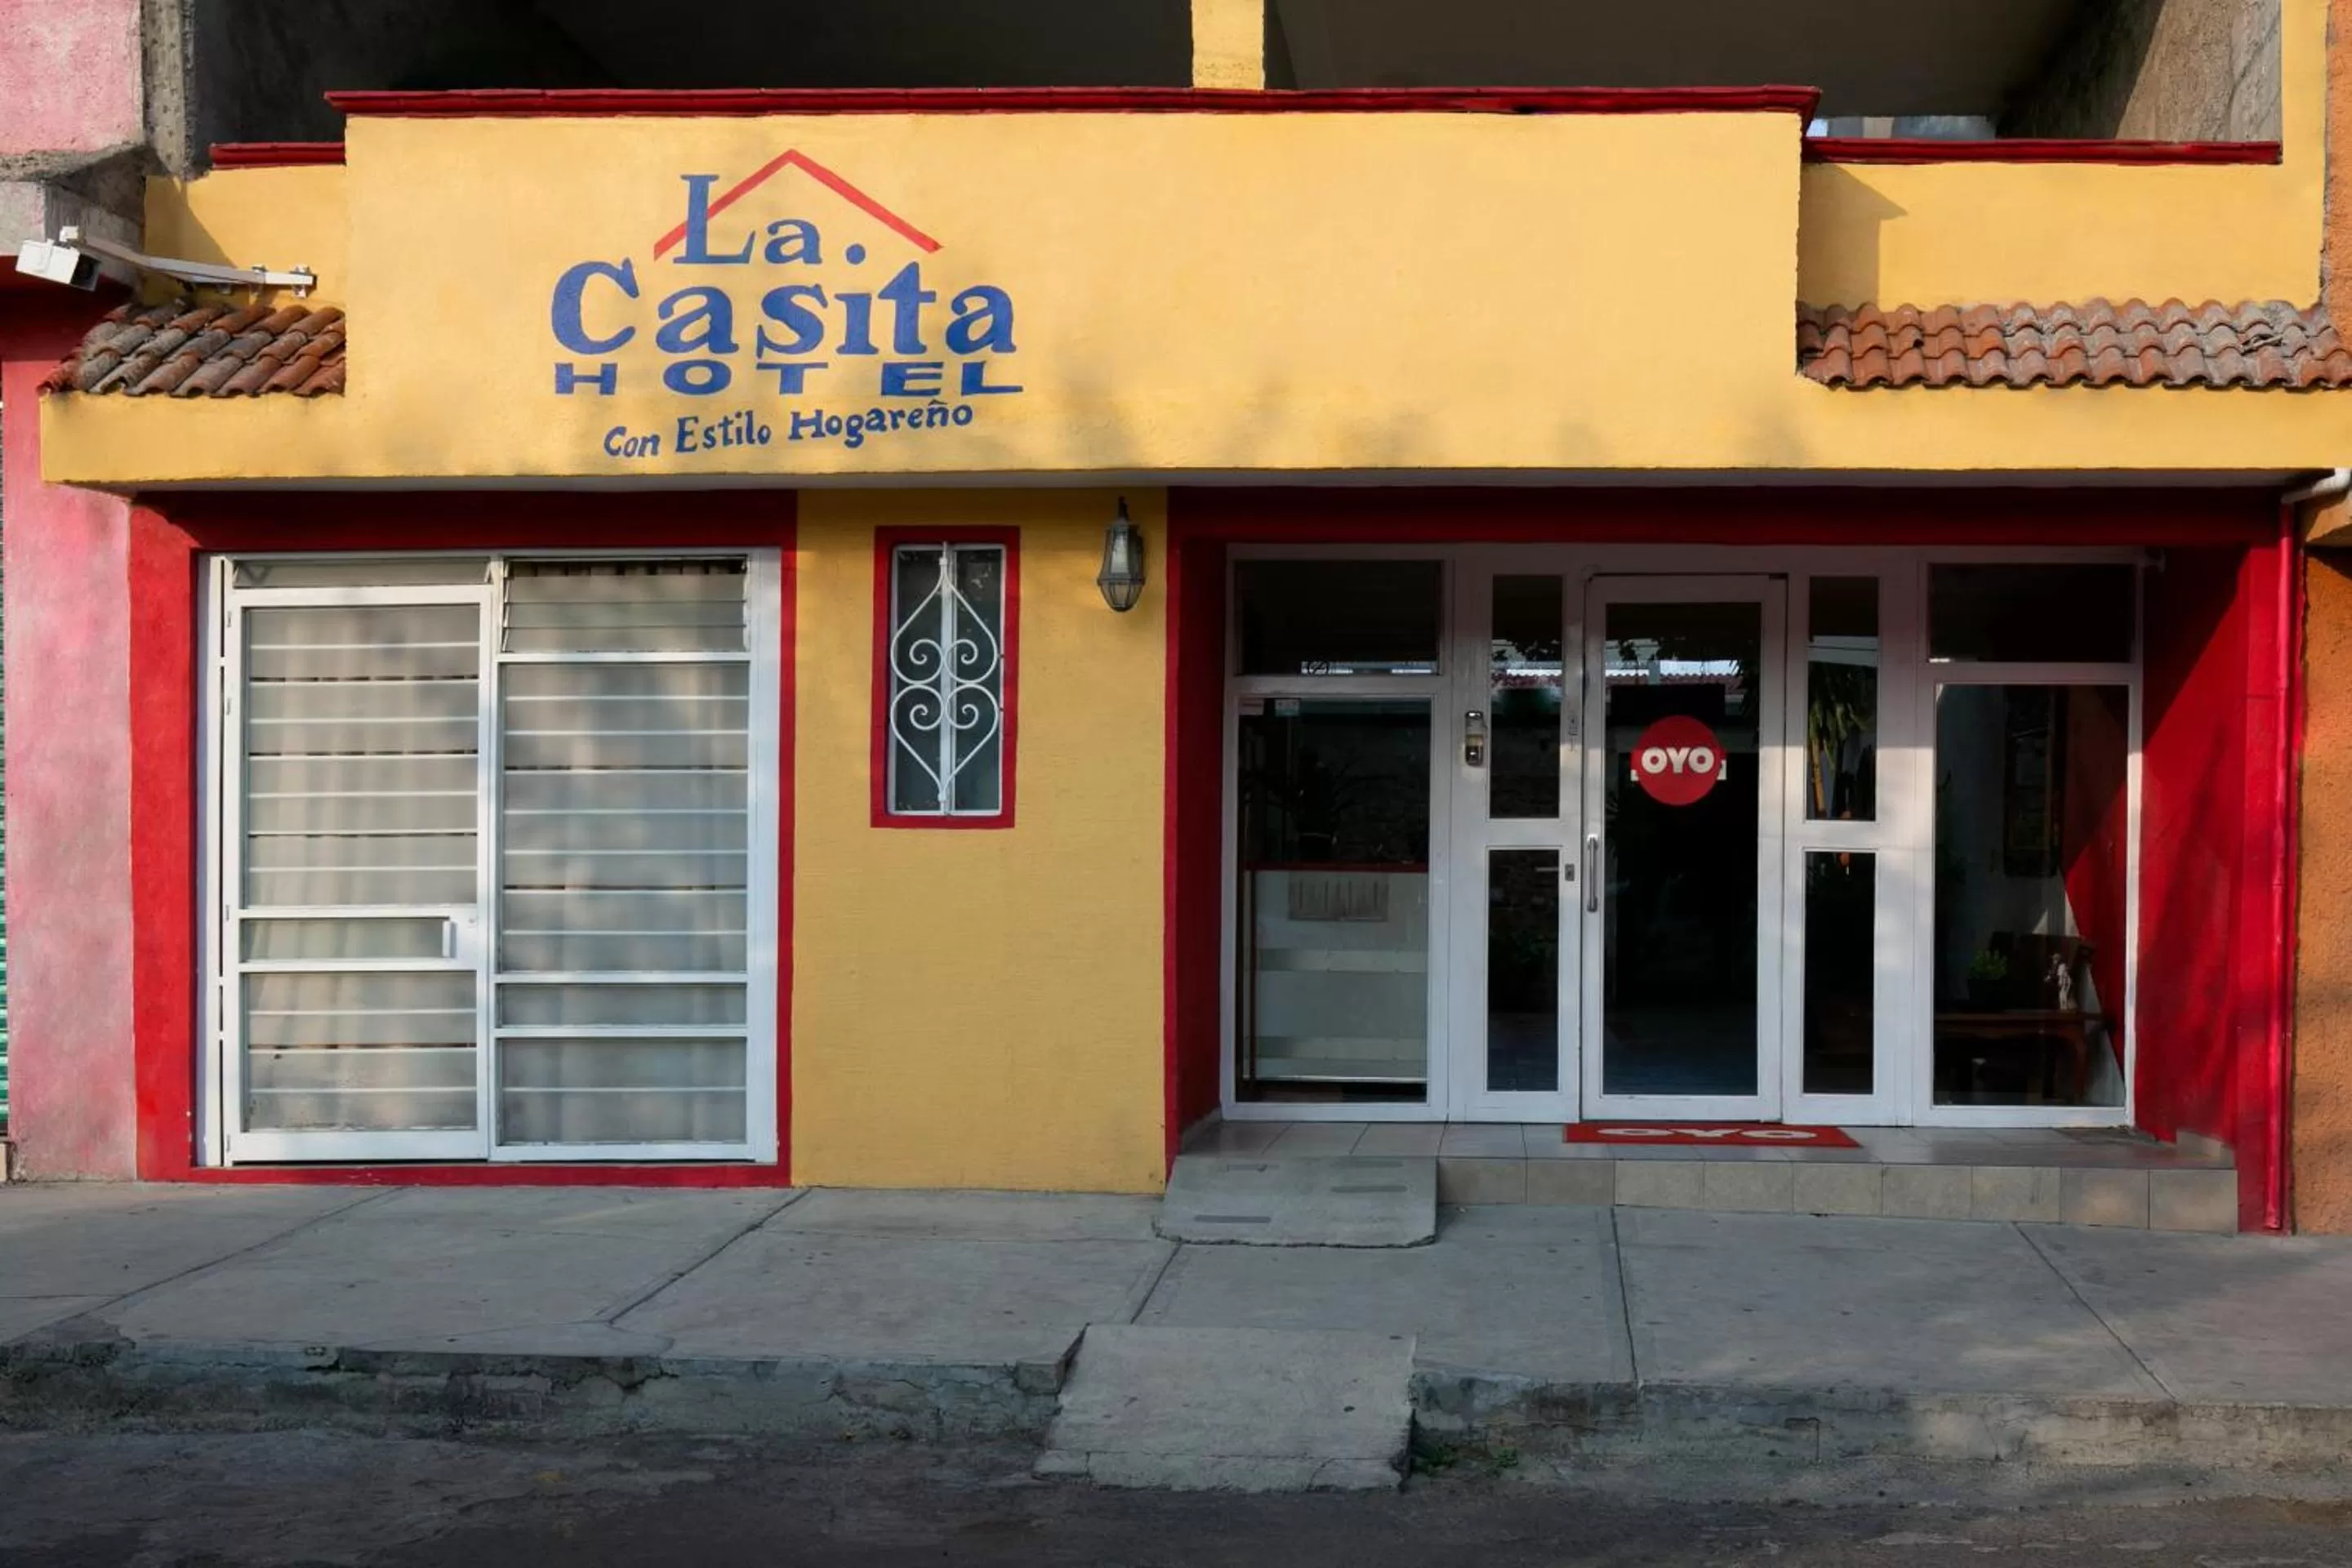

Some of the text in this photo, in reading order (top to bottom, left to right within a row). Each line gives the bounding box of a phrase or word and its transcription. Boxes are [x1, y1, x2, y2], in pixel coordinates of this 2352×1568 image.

[550, 246, 1018, 359] Casita
[555, 359, 1023, 397] HOTEL
[604, 399, 973, 457] Con Estilo Hogareño
[1641, 746, 1715, 774] OYO
[1597, 1127, 1817, 1139] OYO
